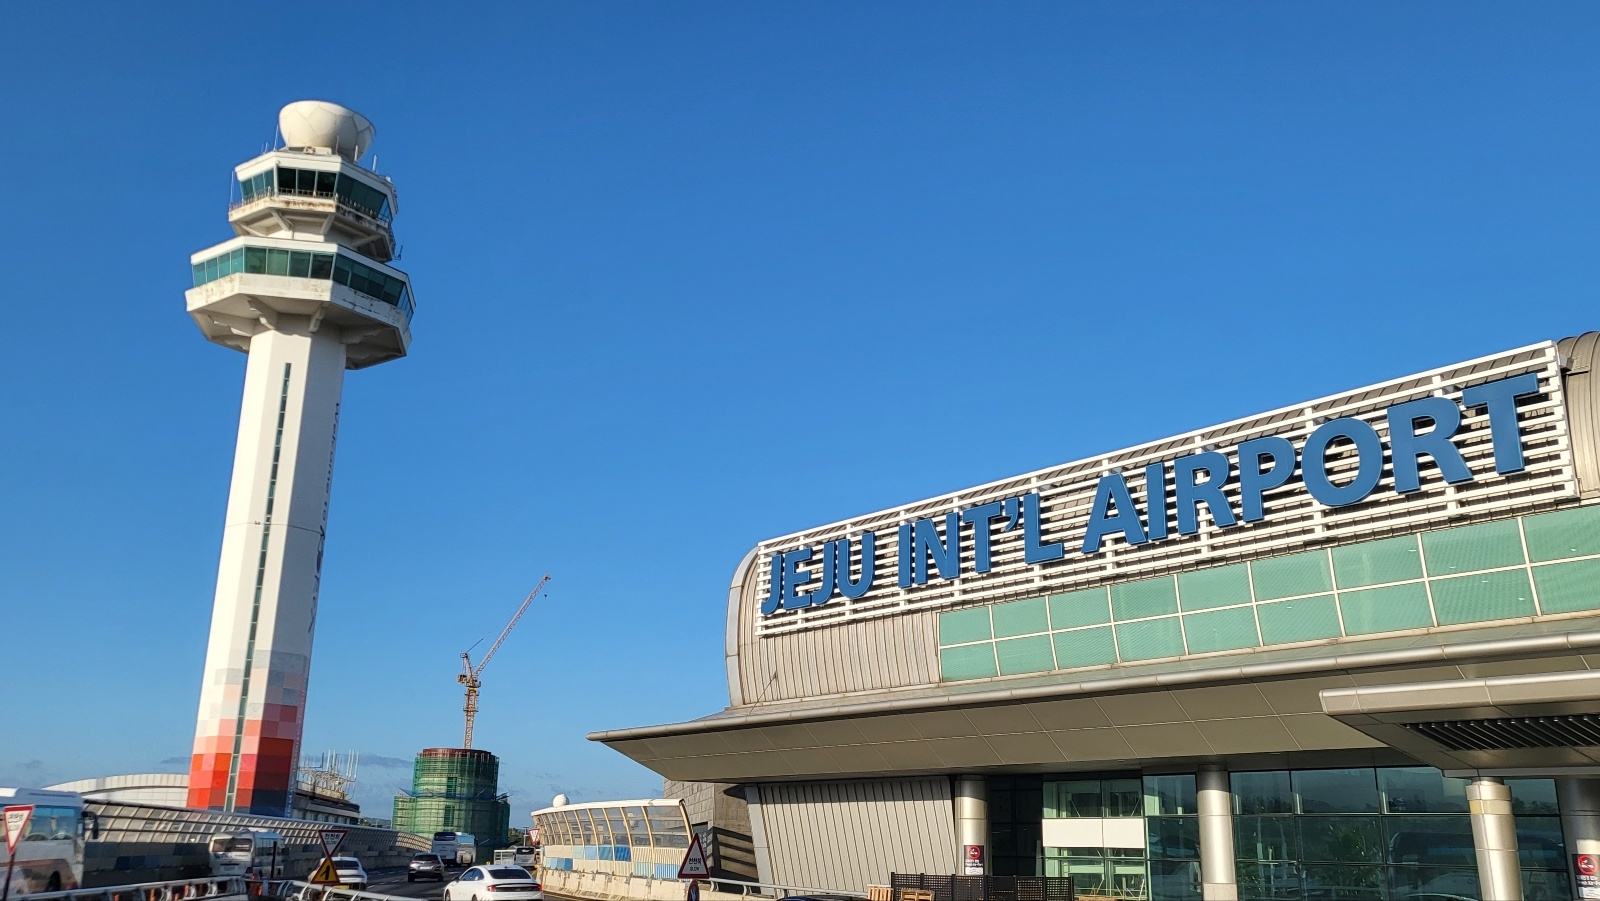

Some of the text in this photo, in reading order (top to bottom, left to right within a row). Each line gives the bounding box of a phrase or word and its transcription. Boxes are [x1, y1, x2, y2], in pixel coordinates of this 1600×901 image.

[761, 372, 1539, 615] JEJU INT'L AIRPORT
